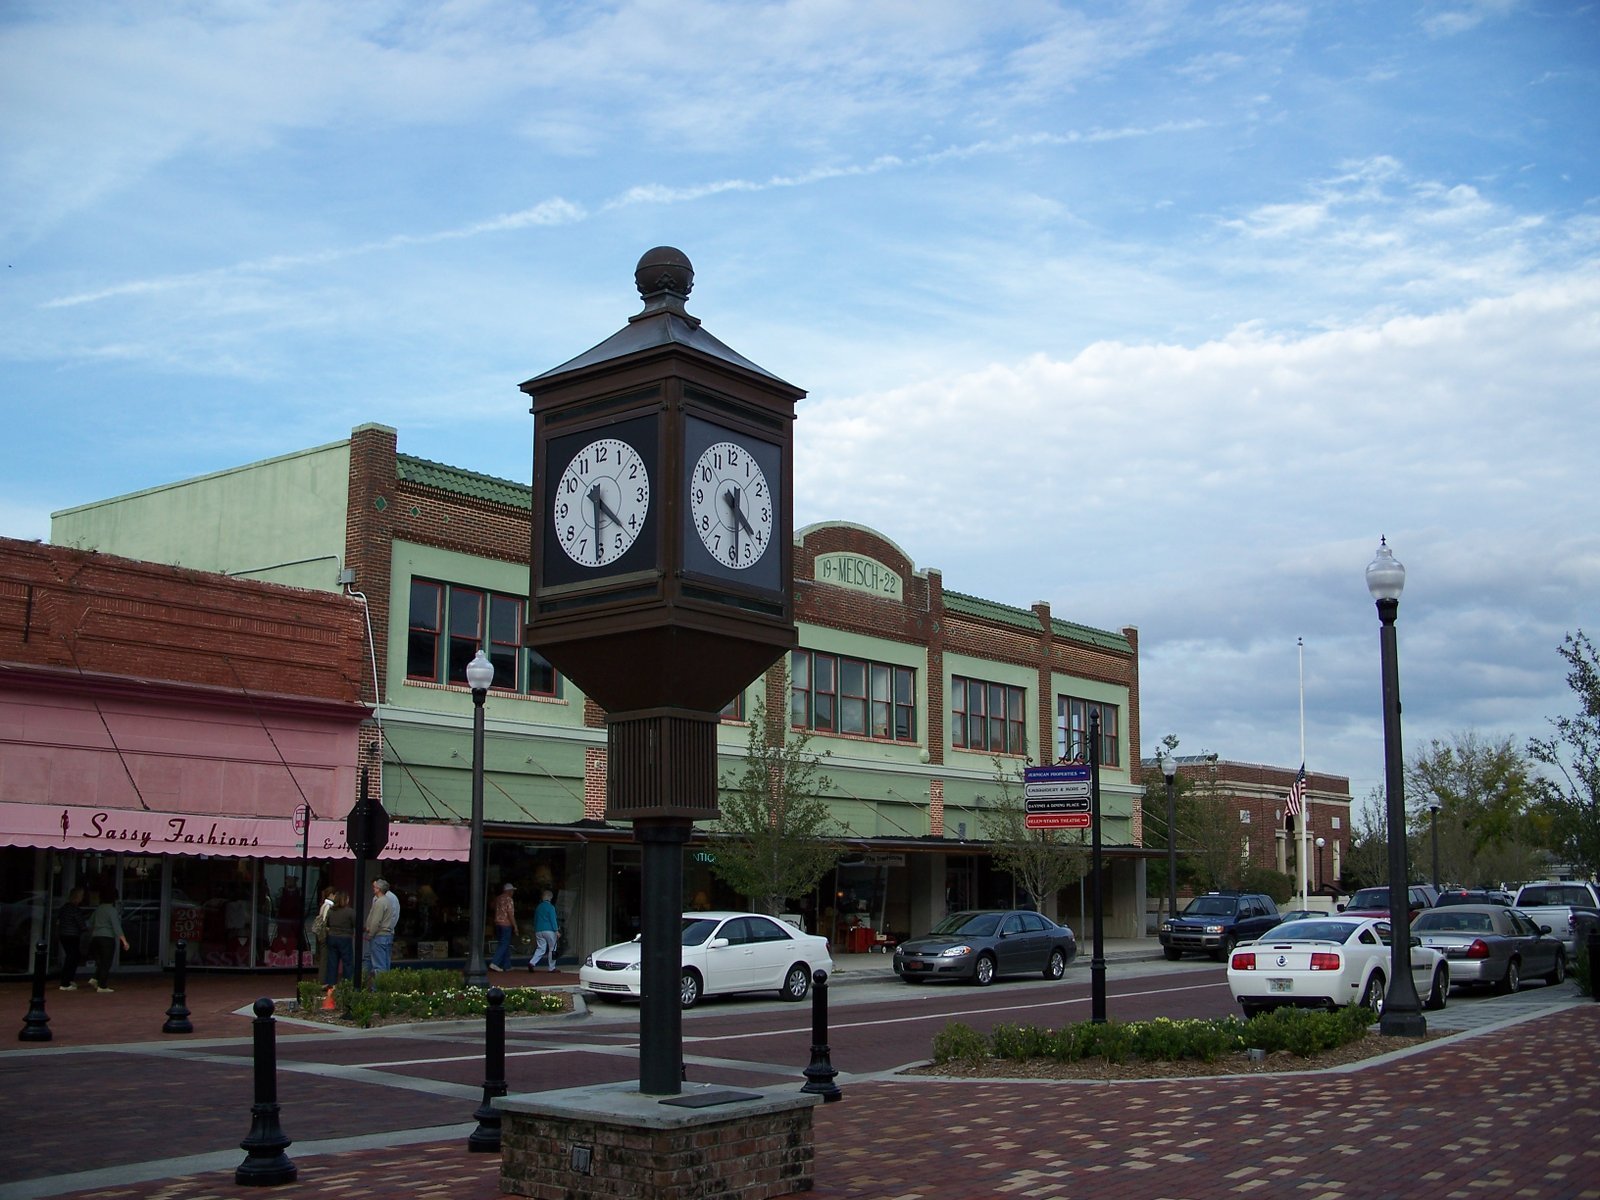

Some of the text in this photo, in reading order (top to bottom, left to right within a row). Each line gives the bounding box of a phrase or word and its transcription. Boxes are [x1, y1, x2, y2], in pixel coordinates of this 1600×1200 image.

[595, 447, 607, 463] 12
[713, 453, 721, 470] 11
[728, 449, 738, 466] 12
[580, 459, 588, 475] 11
[629, 463, 637, 479] 2
[702, 465, 712, 483] 10
[566, 477, 578, 494] 10
[755, 482, 762, 497] 2
[636, 487, 644, 502] 3
[696, 489, 703, 504] 9
[560, 503, 568, 518] 9
[761, 507, 768, 522] 3
[628, 513, 636, 529] 4
[702, 515, 709, 531] 8
[566, 525, 574, 541] 8
[614, 533, 622, 549] 5
[756, 530, 762, 545] 4
[579, 538, 587, 555] 7
[714, 535, 720, 550] 7
[744, 543, 751, 558] 5
[728, 545, 736, 560] 6
[83, 812, 259, 848] Sassy Fashions
[323, 838, 334, 850] &
[190, 951, 249, 967] ASSY
